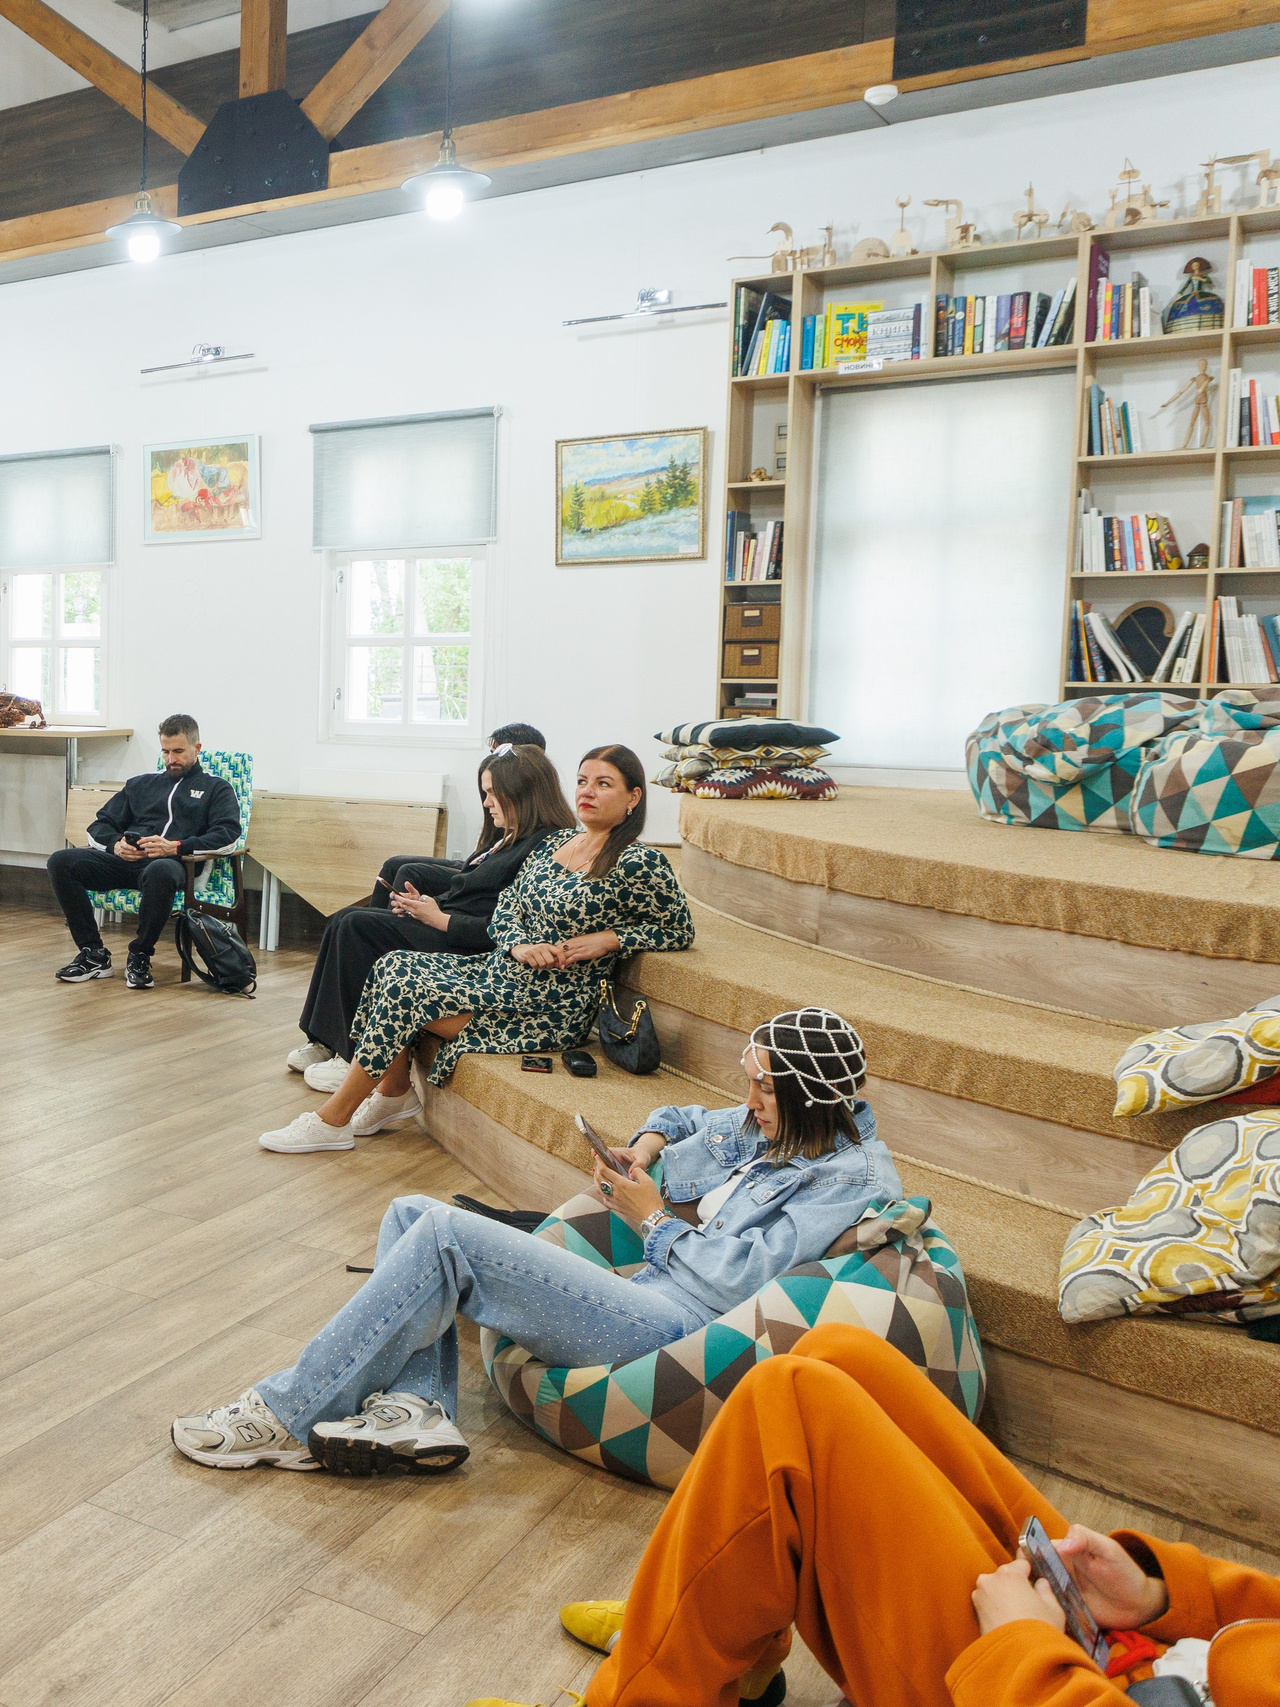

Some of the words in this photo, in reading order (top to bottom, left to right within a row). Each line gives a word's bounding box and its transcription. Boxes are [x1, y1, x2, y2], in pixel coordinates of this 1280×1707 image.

[872, 325, 910, 337] КНИГА
[190, 789, 204, 799] W
[373, 1408, 401, 1422] N
[237, 1423, 262, 1443] N
